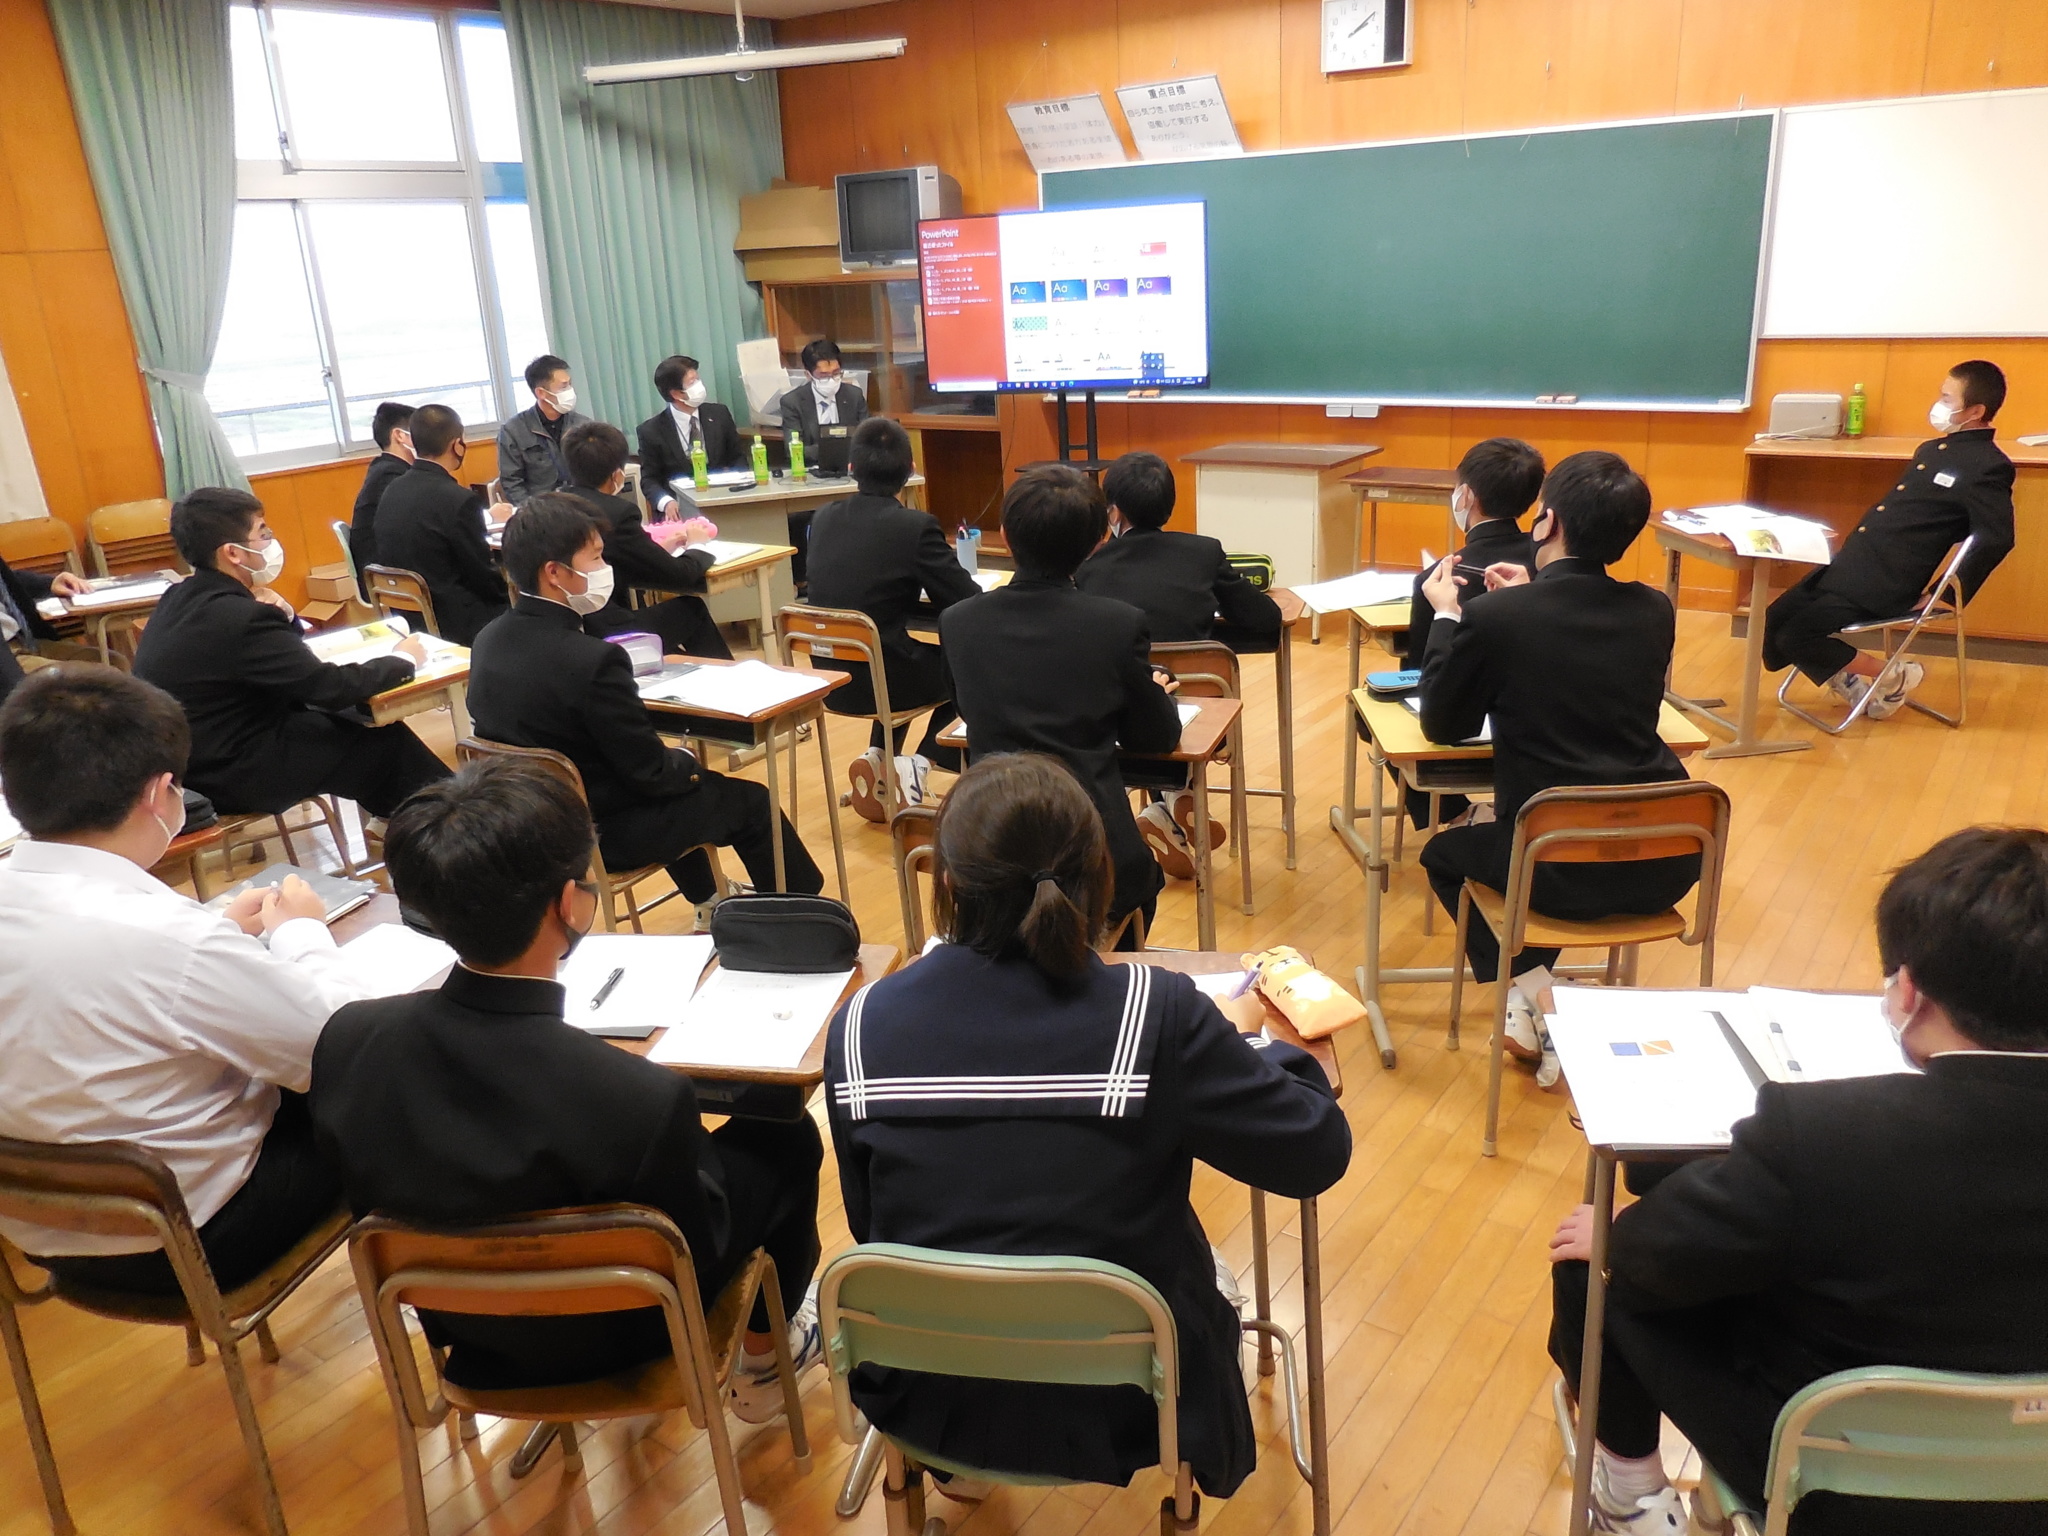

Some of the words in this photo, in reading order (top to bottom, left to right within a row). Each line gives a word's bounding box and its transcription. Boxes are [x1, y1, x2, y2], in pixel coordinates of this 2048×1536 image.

[1148, 85, 1186, 99] 重点目標
[1034, 103, 1070, 116] 教育目標
[921, 229, 959, 239] PowerPoint
[1012, 284, 1027, 295] Aa
[1053, 282, 1068, 293] Aa
[1094, 280, 1110, 292] Aa
[1137, 278, 1153, 290] Aa
